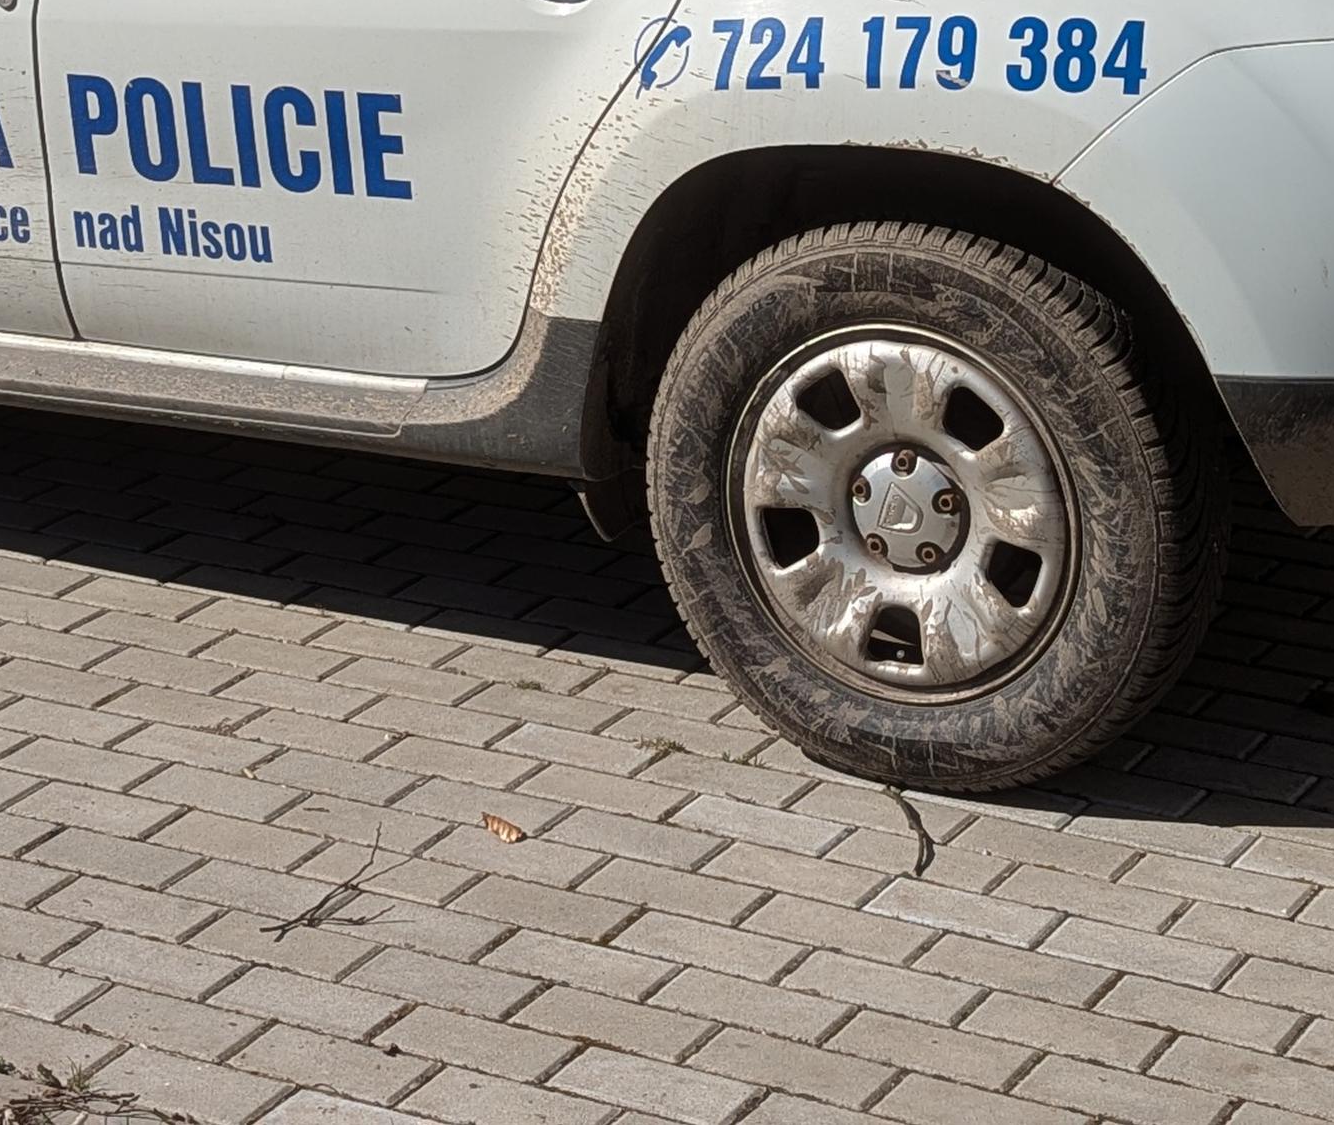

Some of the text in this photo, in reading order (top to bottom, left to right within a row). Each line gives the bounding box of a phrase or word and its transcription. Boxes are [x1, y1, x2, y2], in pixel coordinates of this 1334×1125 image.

[712, 15, 1148, 96] 724 179 384
[67, 74, 413, 200] POLICIE
[74, 207, 142, 261] nad
[160, 207, 273, 264] Nisou
